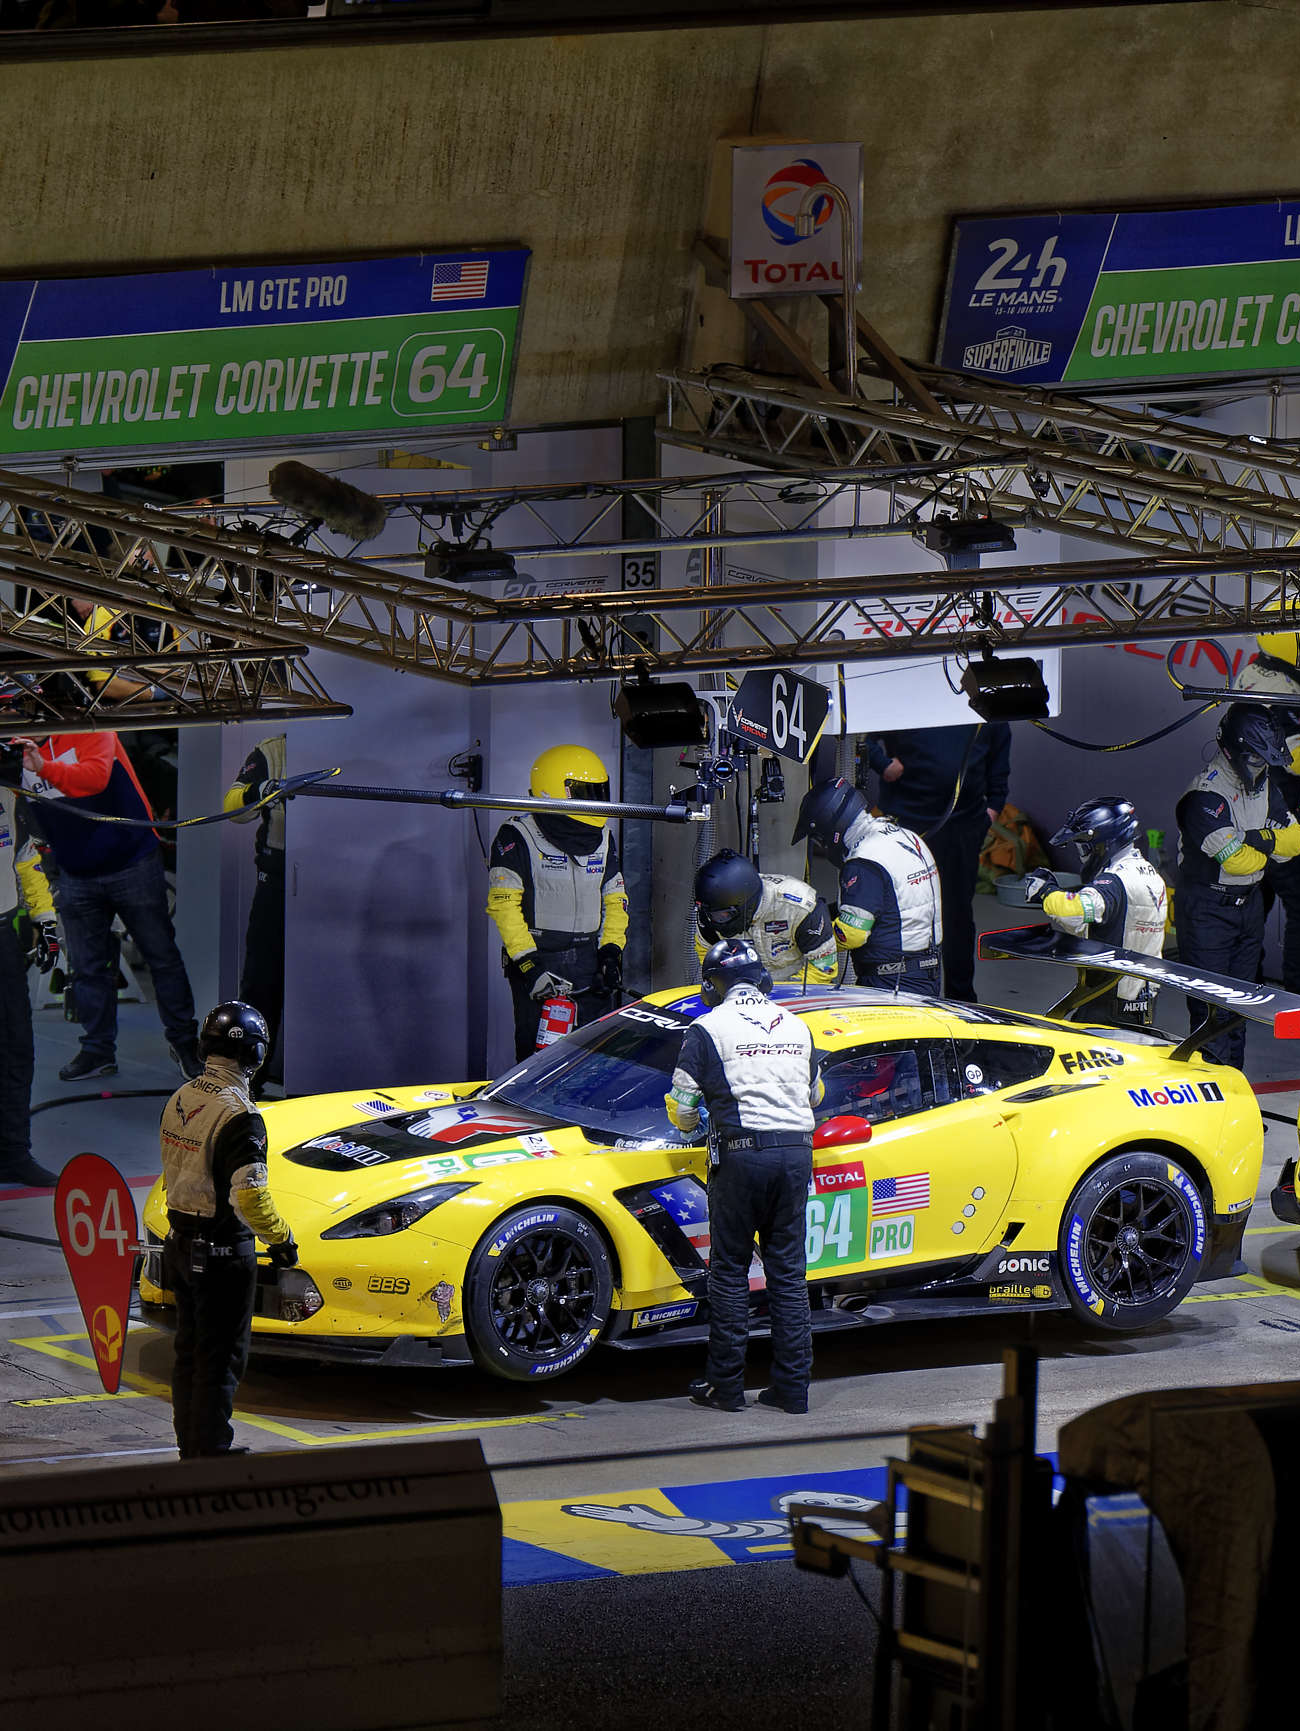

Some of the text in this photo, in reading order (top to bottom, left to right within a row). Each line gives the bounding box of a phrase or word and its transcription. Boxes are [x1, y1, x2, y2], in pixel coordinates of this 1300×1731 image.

[744, 259, 844, 284] TOTAL
[219, 275, 349, 314] LM GTE PRO
[968, 289, 1059, 307] LE MANS
[1089, 294, 1275, 359] CHEVROLET
[963, 337, 1051, 373] SUPERFINALE
[12, 342, 490, 432] CHEVROLET CORVETTE 64
[625, 560, 656, 588] 35
[771, 672, 807, 759] 64
[619, 1007, 691, 1031] CORV
[736, 1049, 803, 1057] RACING
[1127, 1084, 1199, 1107] Mobil
[816, 1171, 865, 1187] TOTAL
[65, 1188, 129, 1257] 64
[503, 1213, 556, 1242] MICHELIN
[805, 1193, 853, 1264] 64
[1183, 1182, 1205, 1256] MICHELIN
[871, 1220, 914, 1254] PRO
[998, 1258, 1050, 1273] sonic
[1069, 1220, 1089, 1296] MICHELIN
[367, 1275, 410, 1295] BBS
[988, 1284, 1032, 1296] braille
[650, 1307, 692, 1322] MICHELIN
[533, 1343, 586, 1374] MICHELIN
